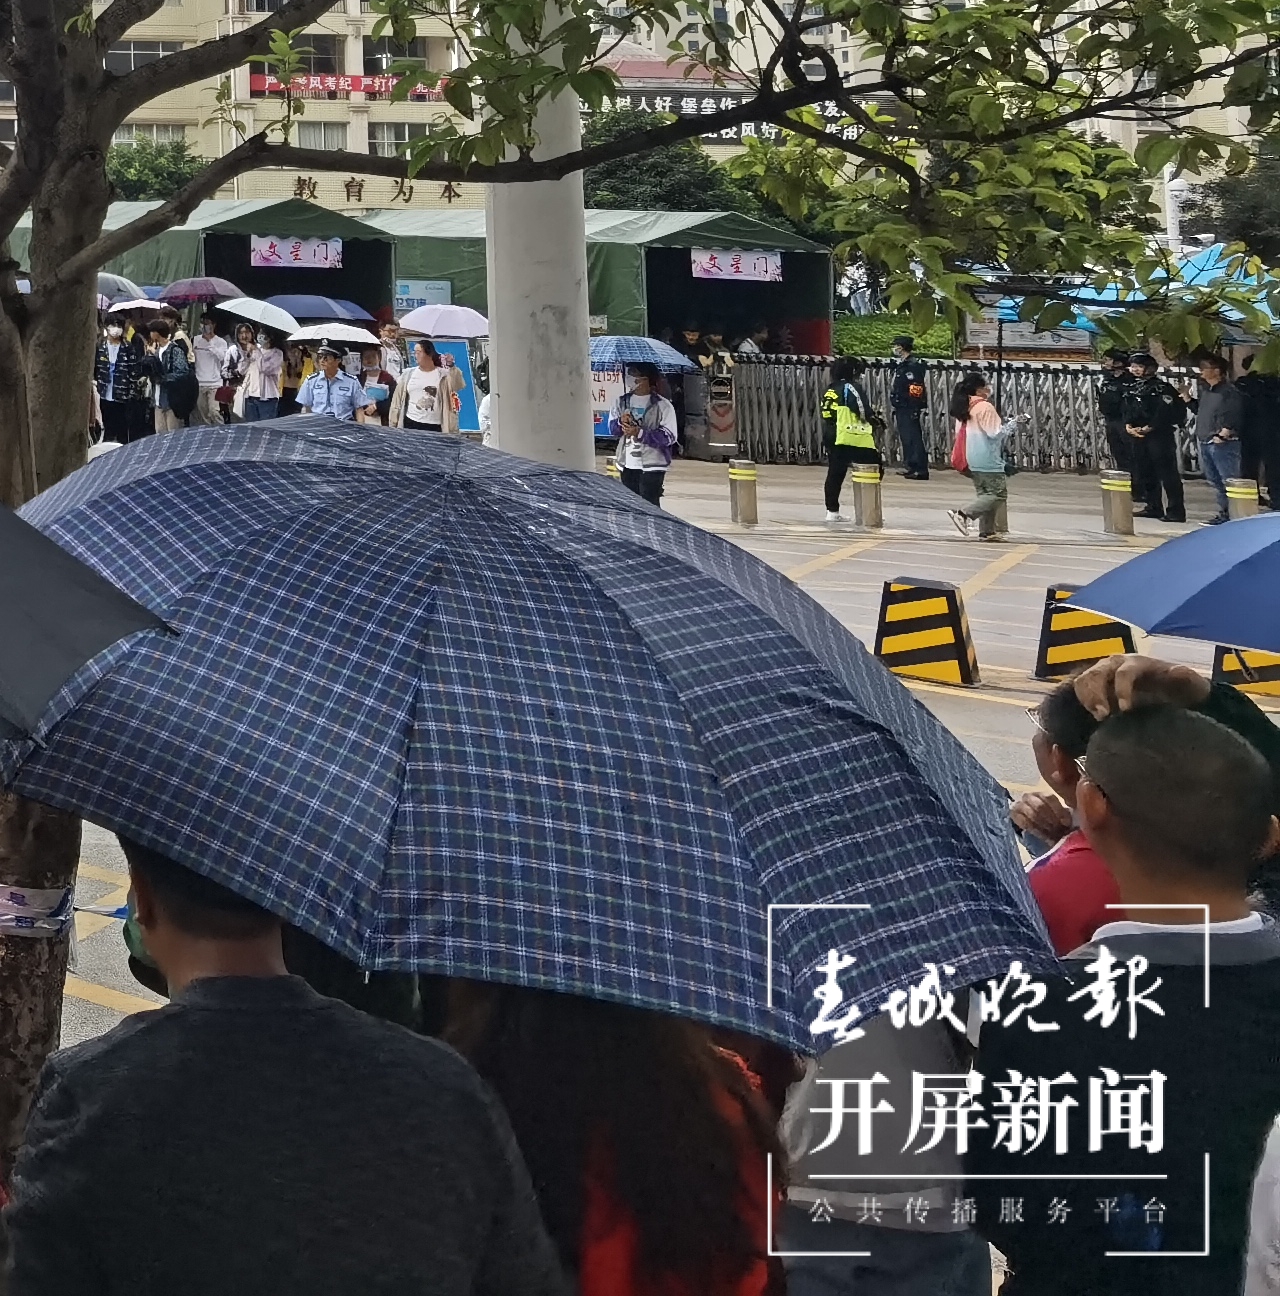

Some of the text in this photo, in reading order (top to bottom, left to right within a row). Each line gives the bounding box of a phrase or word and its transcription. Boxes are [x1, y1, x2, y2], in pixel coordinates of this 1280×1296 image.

[265, 76, 352, 91] 严考风考纪
[295, 175, 463, 203] 教育为本
[268, 240, 329, 262] 文星门
[706, 253, 769, 275] 文星门
